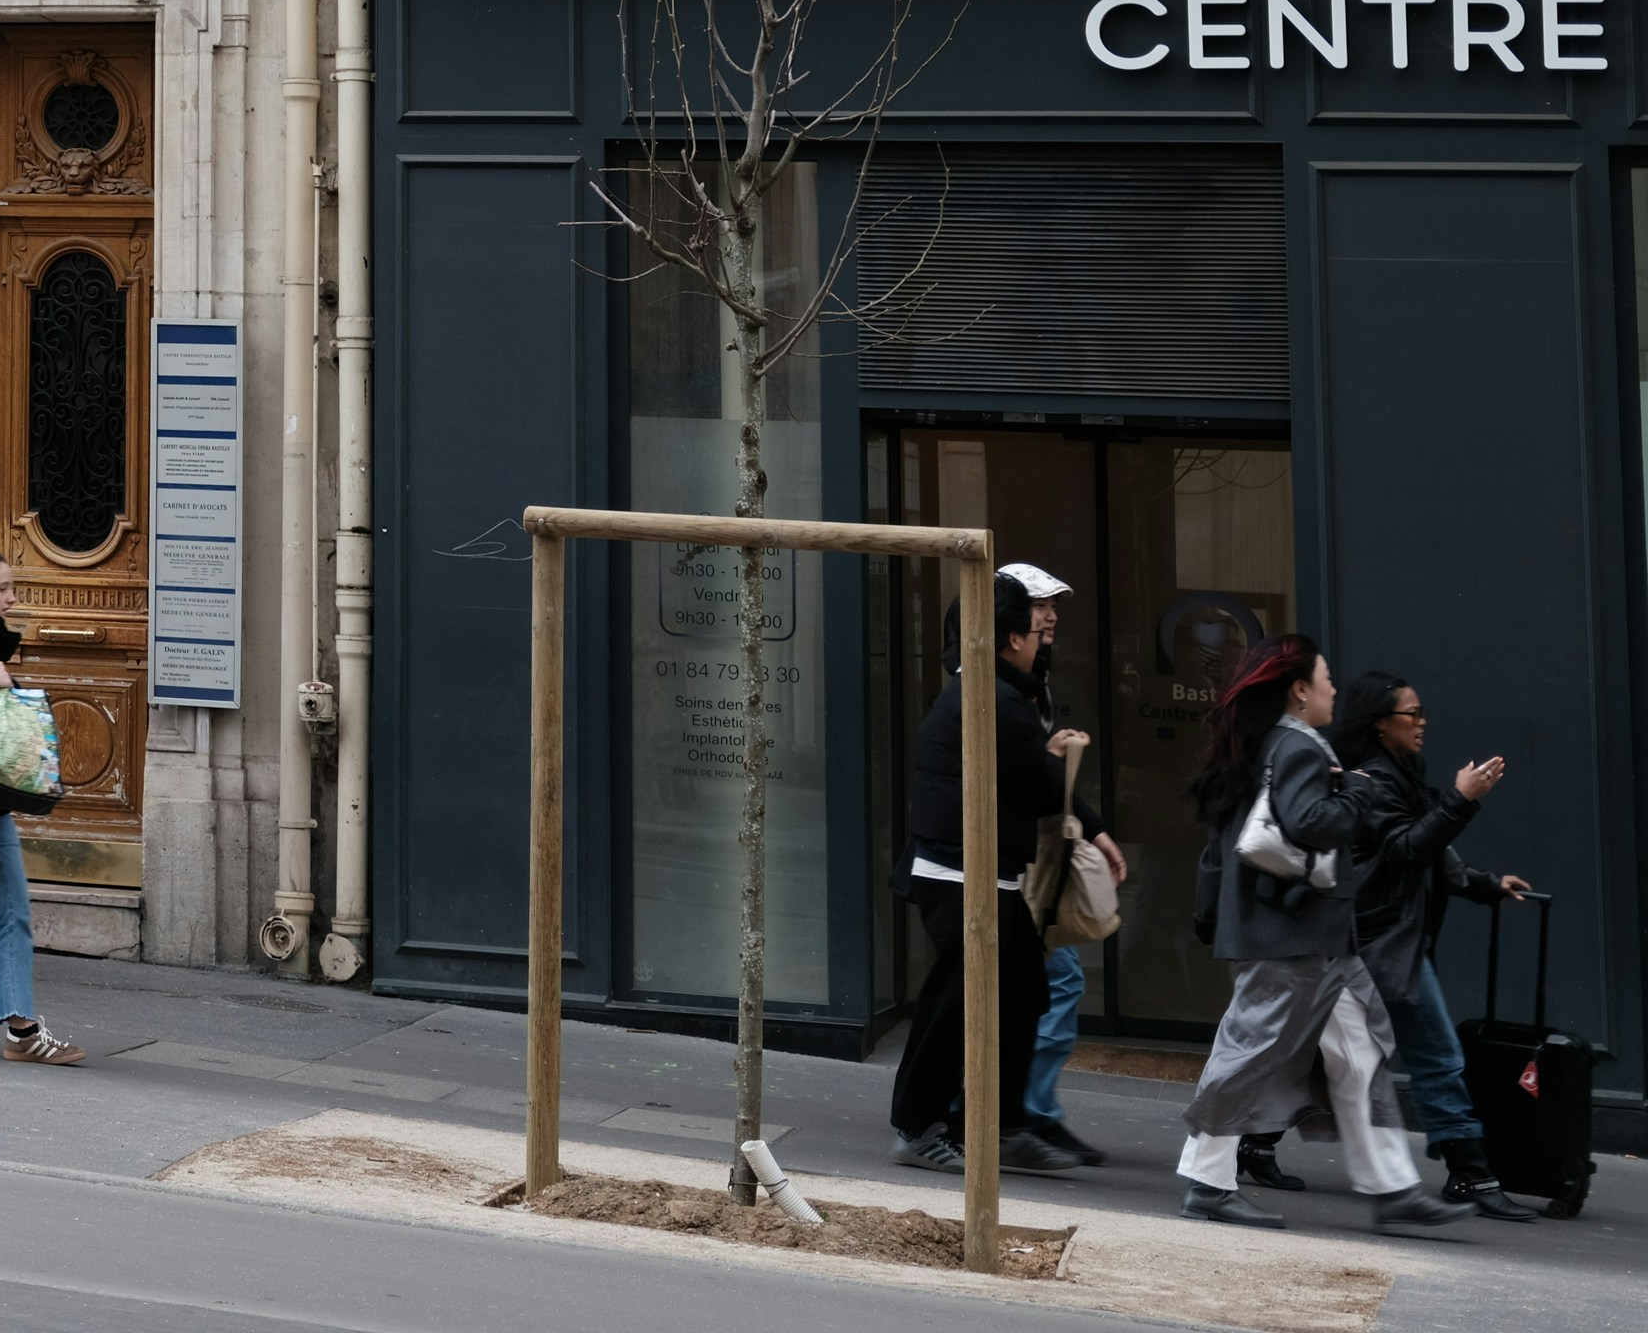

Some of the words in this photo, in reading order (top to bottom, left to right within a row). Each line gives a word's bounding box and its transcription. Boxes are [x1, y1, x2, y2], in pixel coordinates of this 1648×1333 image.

[163, 502, 190, 510] CABINET
[192, 503, 227, 511] D'AVOCATS
[675, 564, 715, 577] 9h30
[694, 588, 764, 603] Vendri
[196, 610, 230, 618] GENERALE
[675, 610, 715, 625] 9h30
[164, 646, 190, 654] Docteur
[201, 648, 225, 656] GALIN
[656, 661, 677, 677] 01
[686, 662, 709, 678] 84
[717, 664, 740, 680] 79
[776, 667, 800, 684] 30
[674, 695, 713, 710] Soins
[1139, 703, 1200, 721] Centre
[682, 732, 776, 749] Implantole
[672, 767, 698, 776] PRISE
[701, 768, 712, 777] DE
[715, 770, 733, 779] RDV
